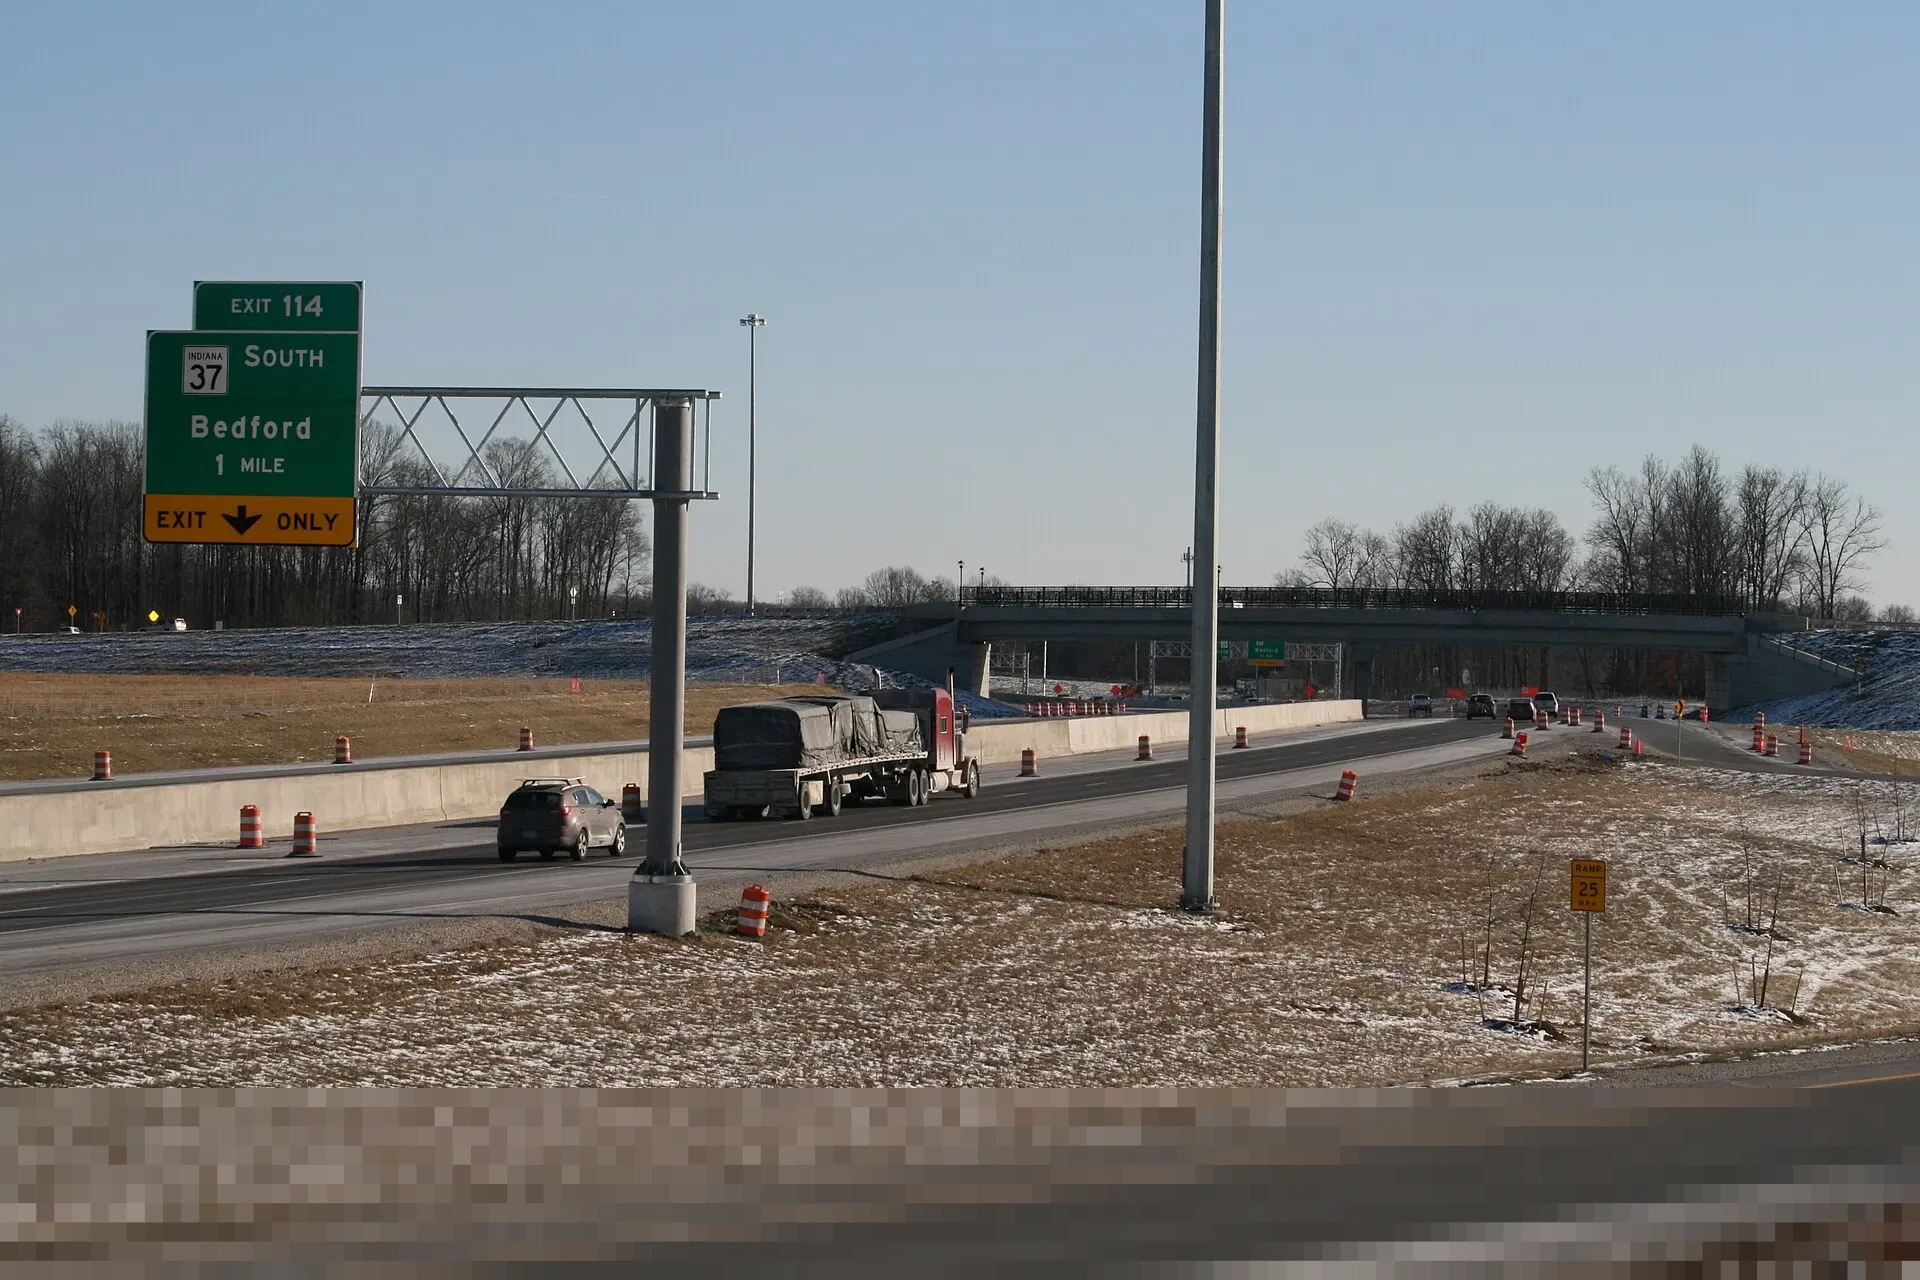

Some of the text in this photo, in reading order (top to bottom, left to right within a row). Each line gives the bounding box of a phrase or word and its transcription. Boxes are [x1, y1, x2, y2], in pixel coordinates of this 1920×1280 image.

[231, 294, 323, 317] EXIT 114
[188, 352, 223, 360] INDIANA
[244, 345, 323, 368] SOUTH
[189, 364, 223, 390] 37
[191, 415, 311, 439] Bedford
[215, 453, 285, 476] 1 MILE
[157, 510, 340, 531] EXIT ONLY
[1575, 864, 1602, 872] RAMP
[1579, 881, 1598, 897] 25
